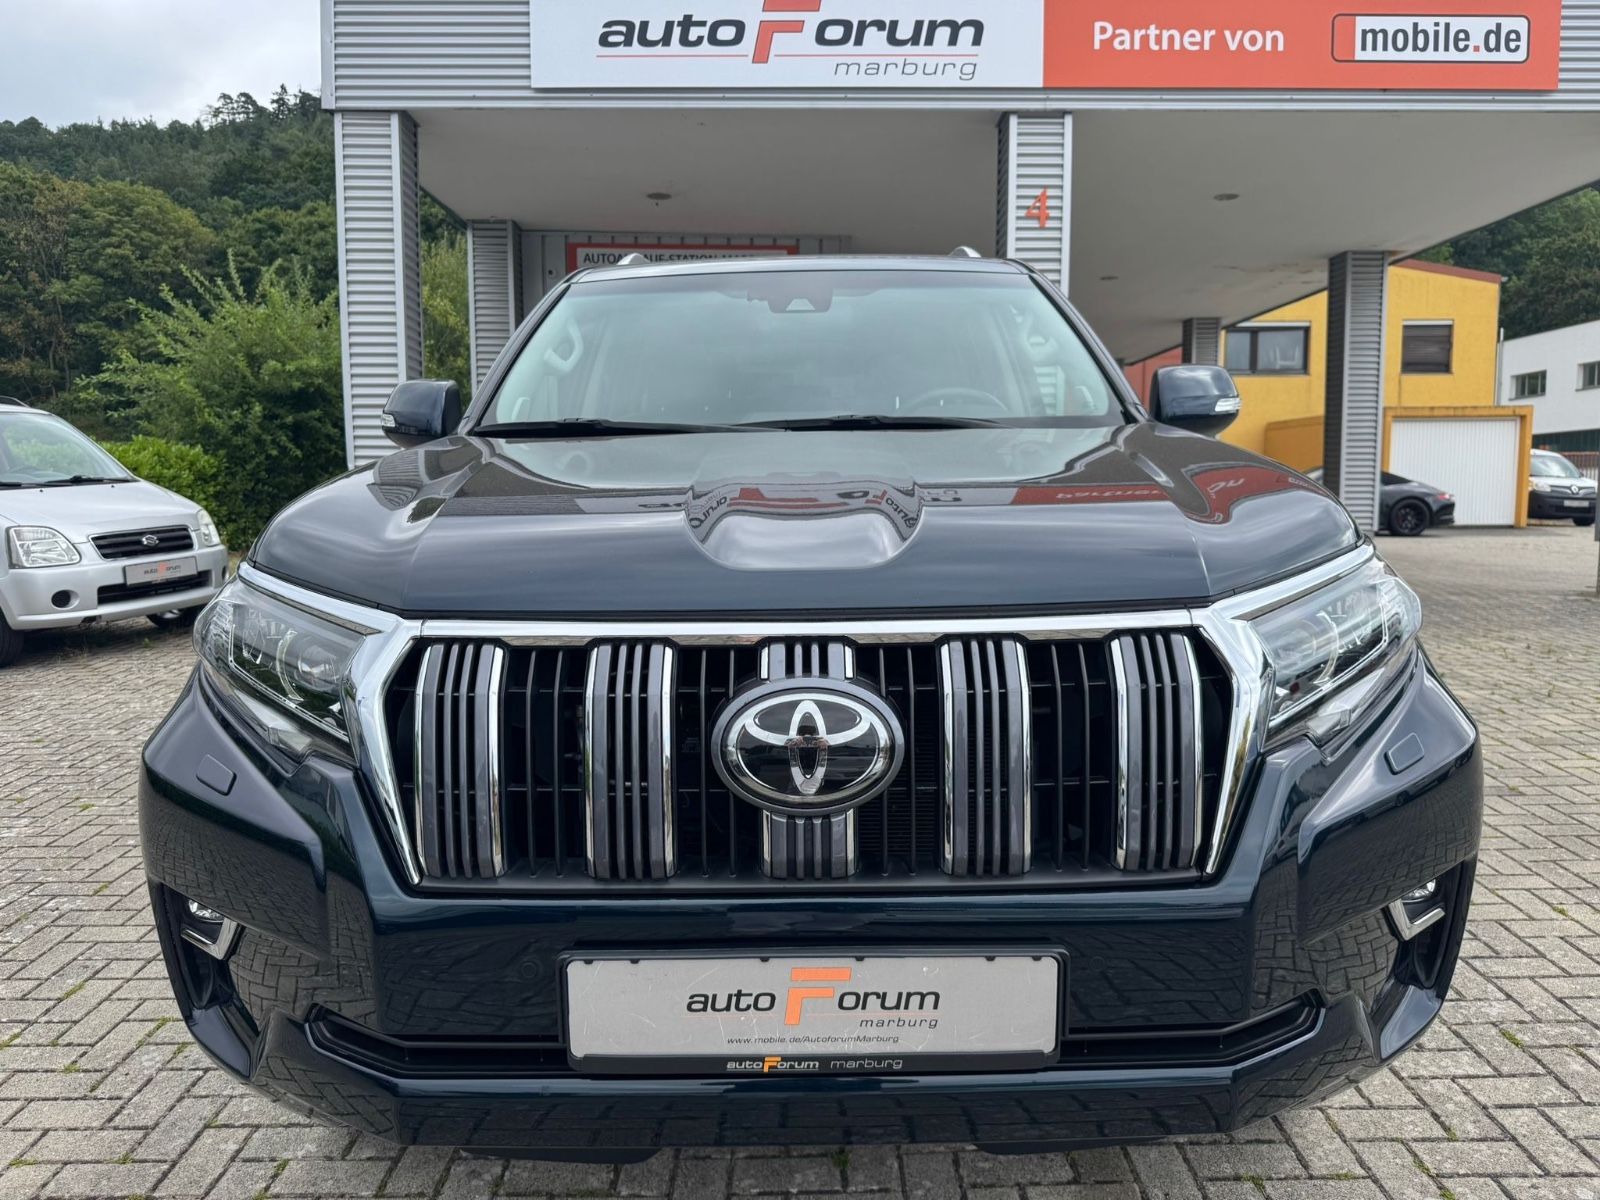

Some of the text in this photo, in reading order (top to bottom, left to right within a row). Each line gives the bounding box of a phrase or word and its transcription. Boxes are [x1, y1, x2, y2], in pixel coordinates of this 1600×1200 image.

[1093, 21, 1285, 52] Partner von
[1360, 22, 1522, 53] mobile.de
[834, 58, 978, 81] marburg
[1024, 185, 1050, 230] 4
[859, 1017, 939, 1029] marburg
[726, 1056, 903, 1073] autoForum marburg
